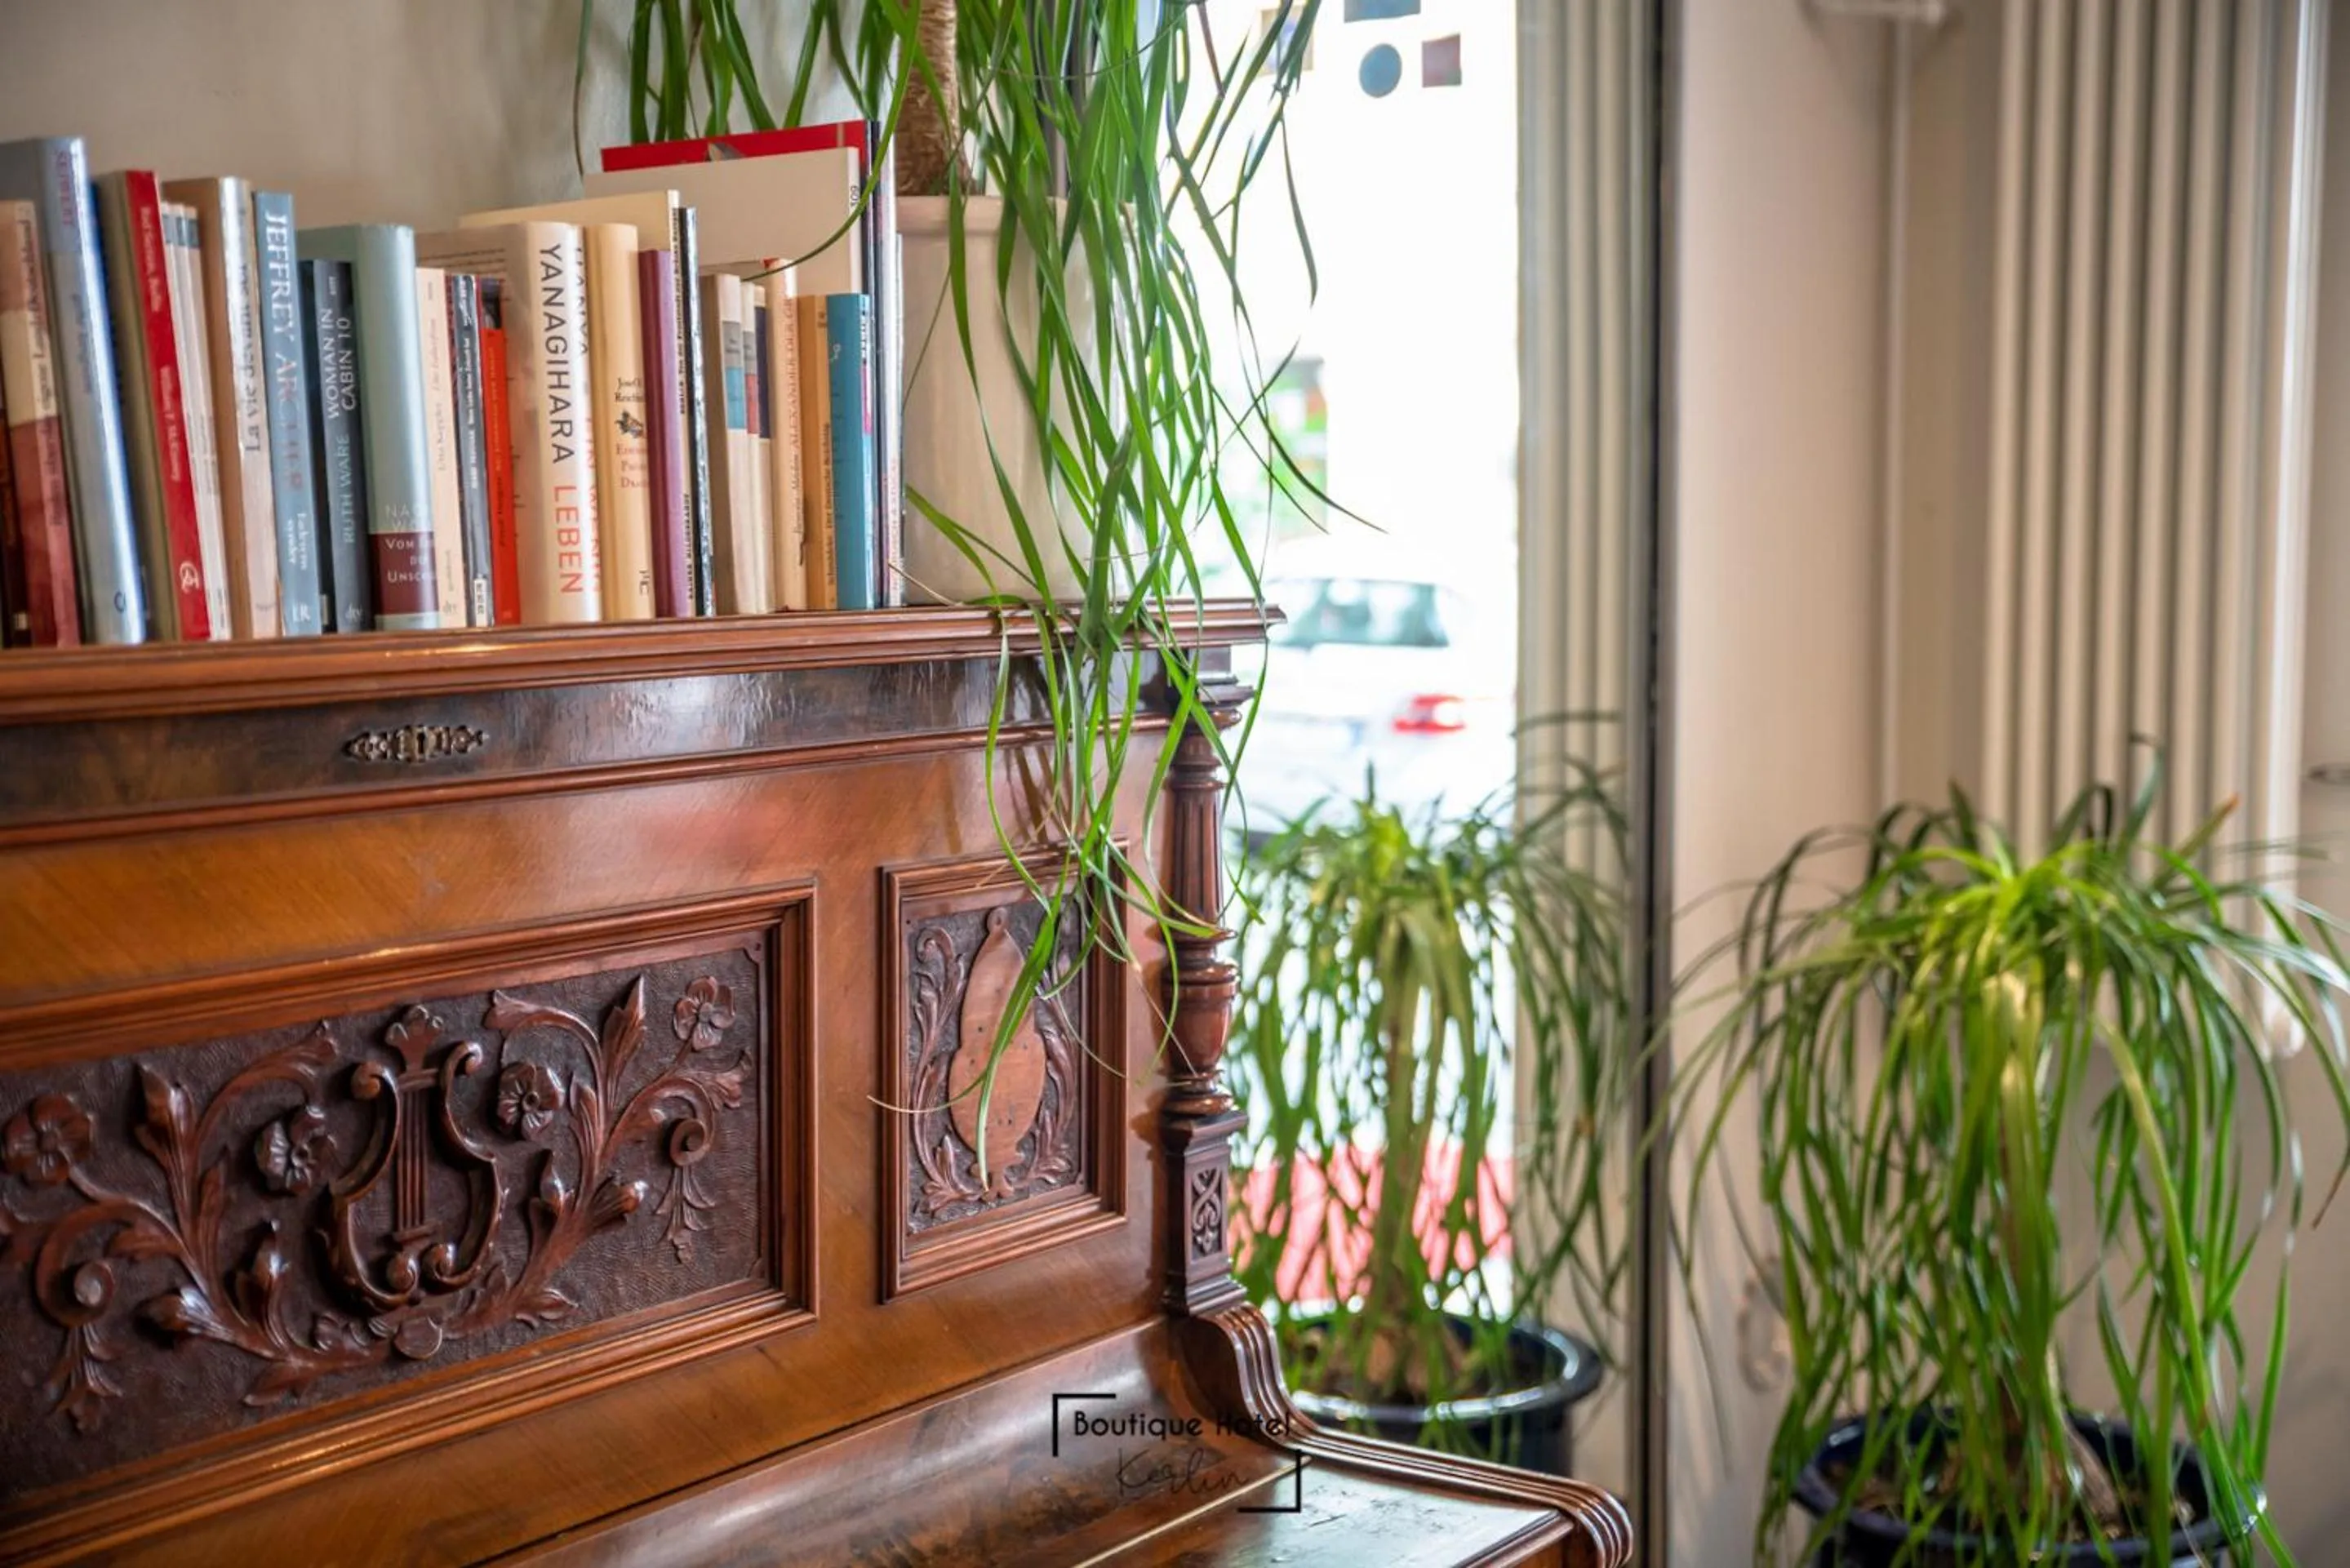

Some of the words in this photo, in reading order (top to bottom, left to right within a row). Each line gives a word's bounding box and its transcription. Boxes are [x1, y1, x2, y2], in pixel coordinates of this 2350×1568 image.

[265, 211, 295, 342] JEFFREY
[320, 307, 334, 329] IN
[335, 317, 352, 339] 10
[322, 337, 340, 419] WOMAN
[337, 349, 357, 411] CABIN
[540, 244, 575, 464] YANAGIHARA
[245, 384, 260, 417] vie
[246, 426, 261, 453] La
[336, 433, 351, 487] WARE
[340, 493, 355, 544] RUTH
[553, 485, 584, 593] LEBEN
